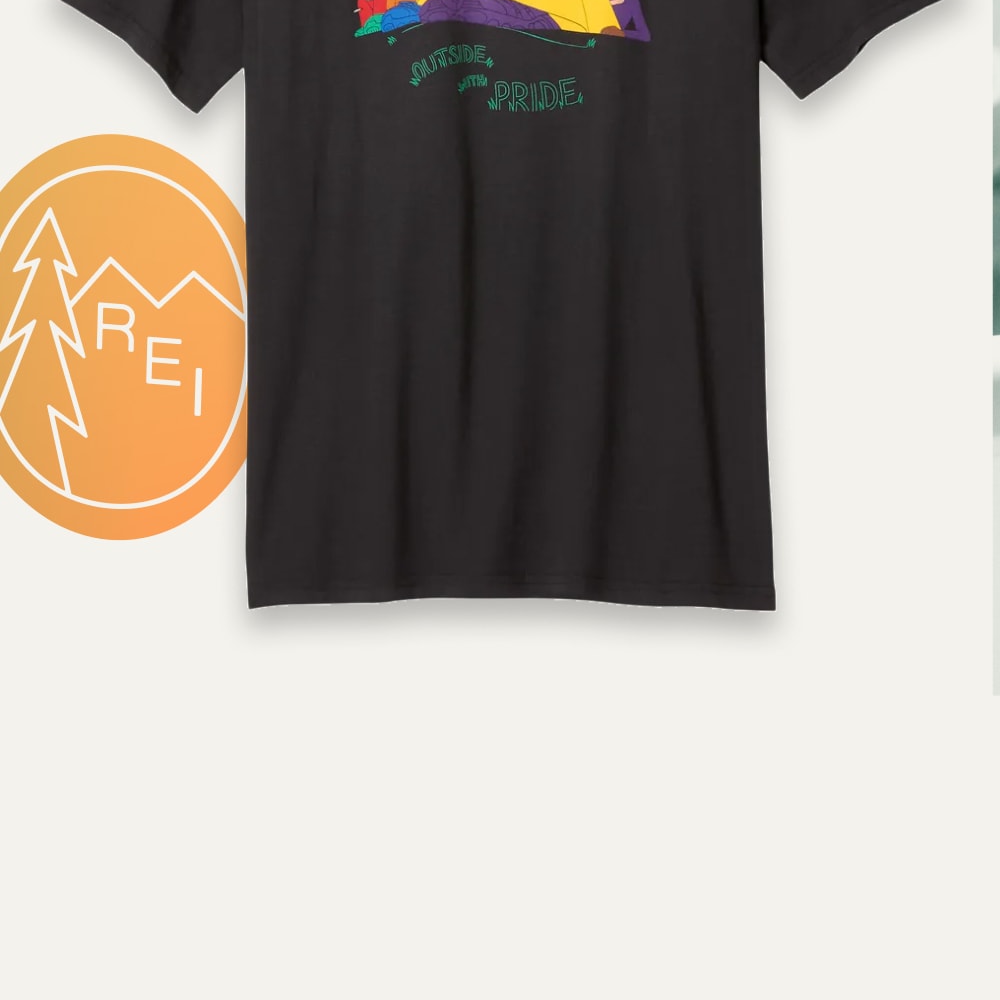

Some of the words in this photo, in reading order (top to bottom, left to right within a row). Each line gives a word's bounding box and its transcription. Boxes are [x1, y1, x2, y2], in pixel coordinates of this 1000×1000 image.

[410, 44, 489, 86] OUTSIDE
[458, 73, 489, 94] WITH
[489, 76, 584, 112] PRIDE
